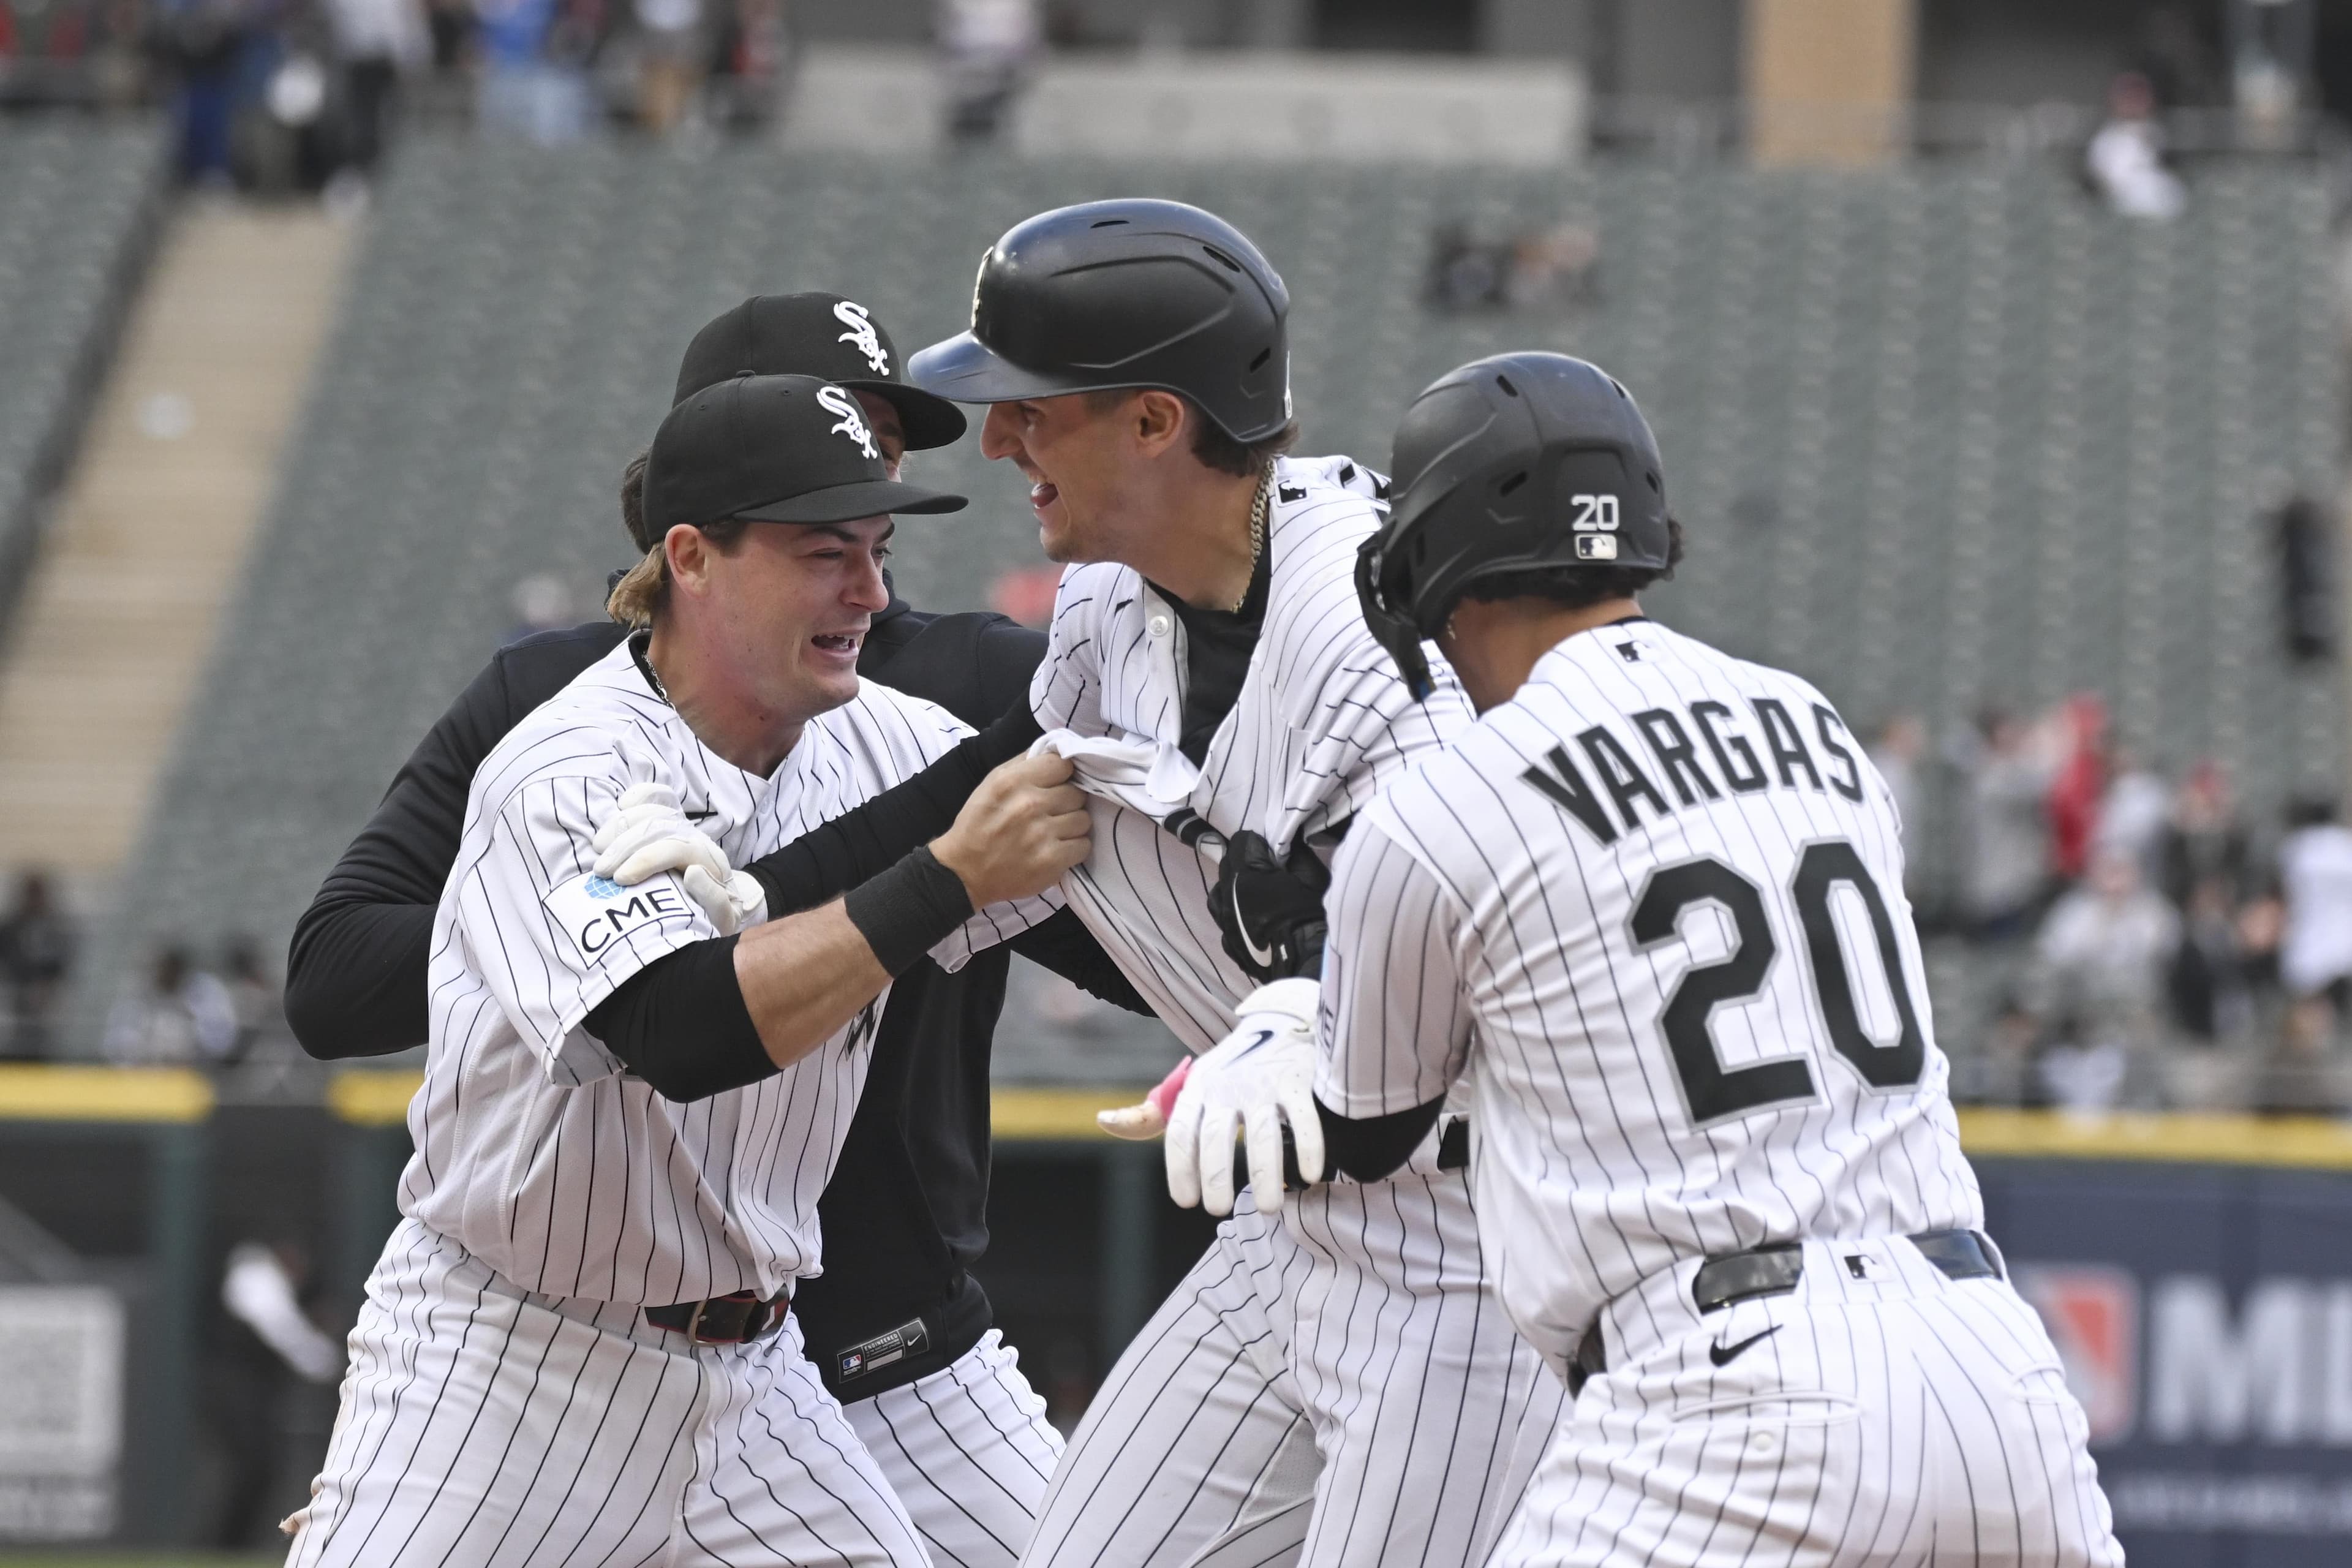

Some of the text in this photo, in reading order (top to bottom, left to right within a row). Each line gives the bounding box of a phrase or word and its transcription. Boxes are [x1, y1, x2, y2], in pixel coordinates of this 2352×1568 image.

[1570, 494, 1619, 531] 20
[1517, 697, 1866, 851] VARGAS
[581, 888, 684, 953] CME
[1624, 835, 1932, 1134] 20
